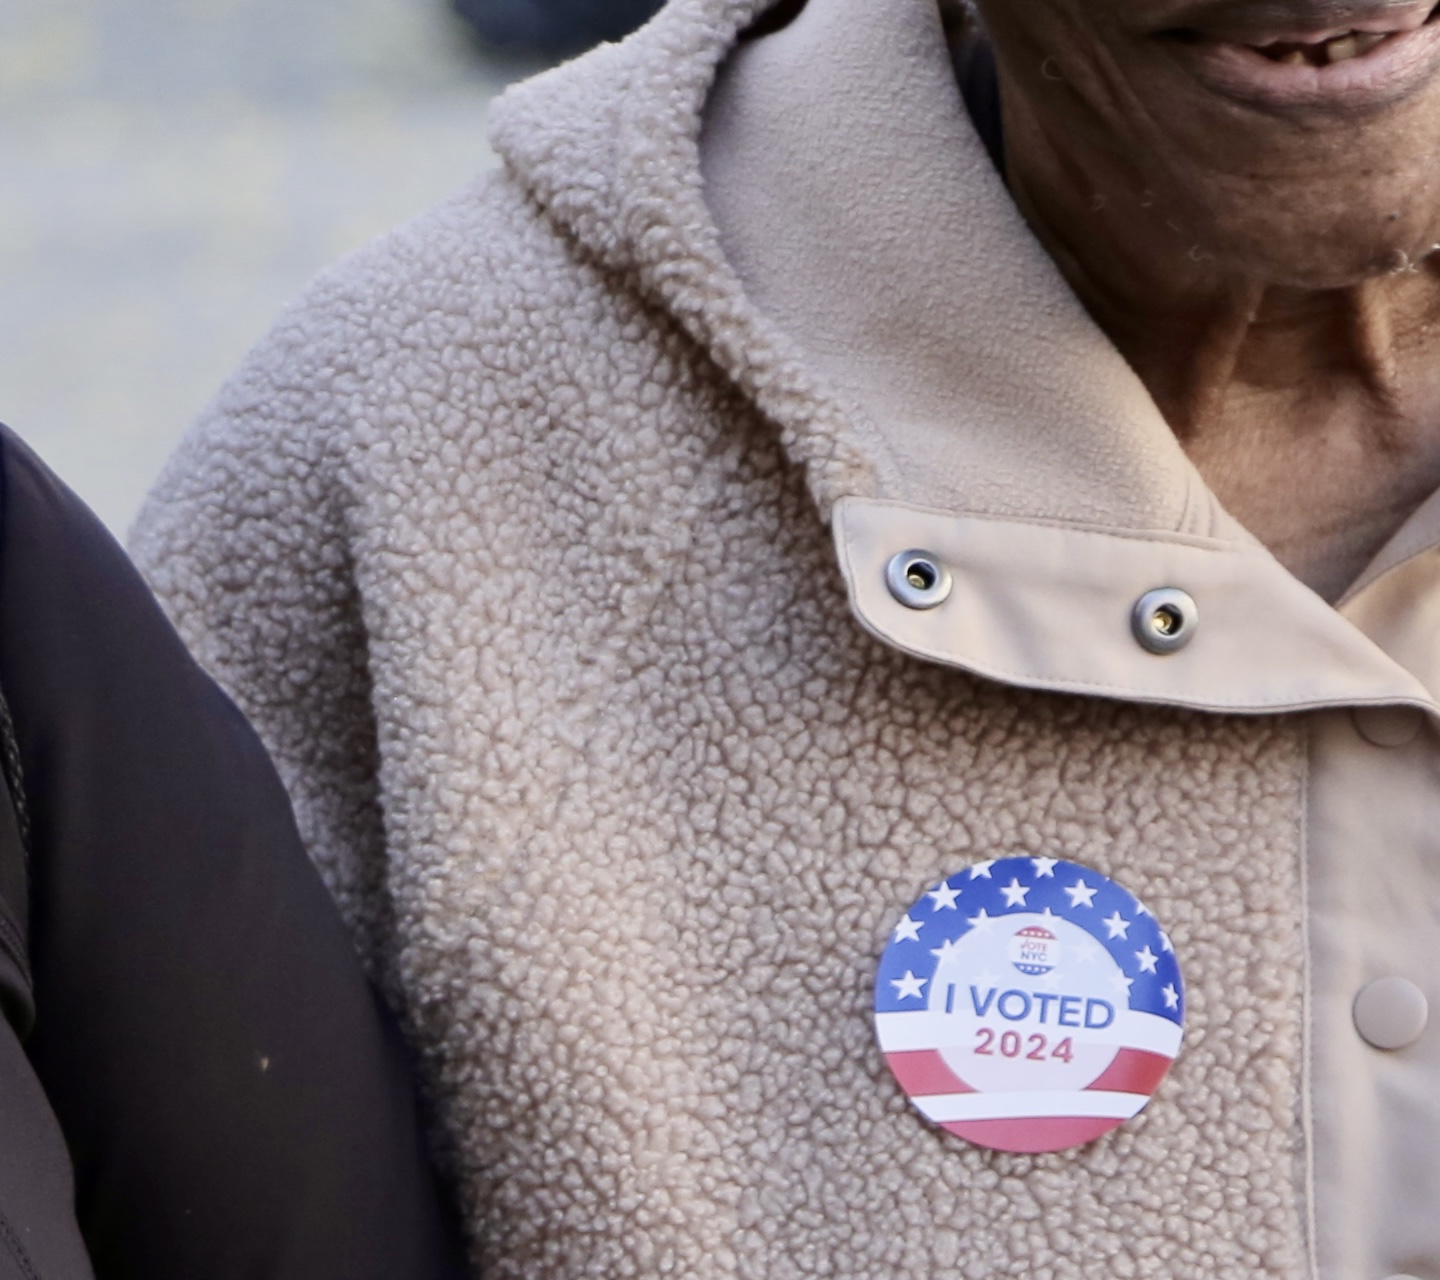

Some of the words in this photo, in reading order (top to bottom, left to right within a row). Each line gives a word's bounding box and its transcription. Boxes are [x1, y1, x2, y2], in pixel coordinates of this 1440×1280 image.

[1021, 951, 1048, 962] NYC
[945, 983, 956, 1014] I
[970, 985, 1116, 1029] VOTED
[974, 1027, 1074, 1063] 2024
